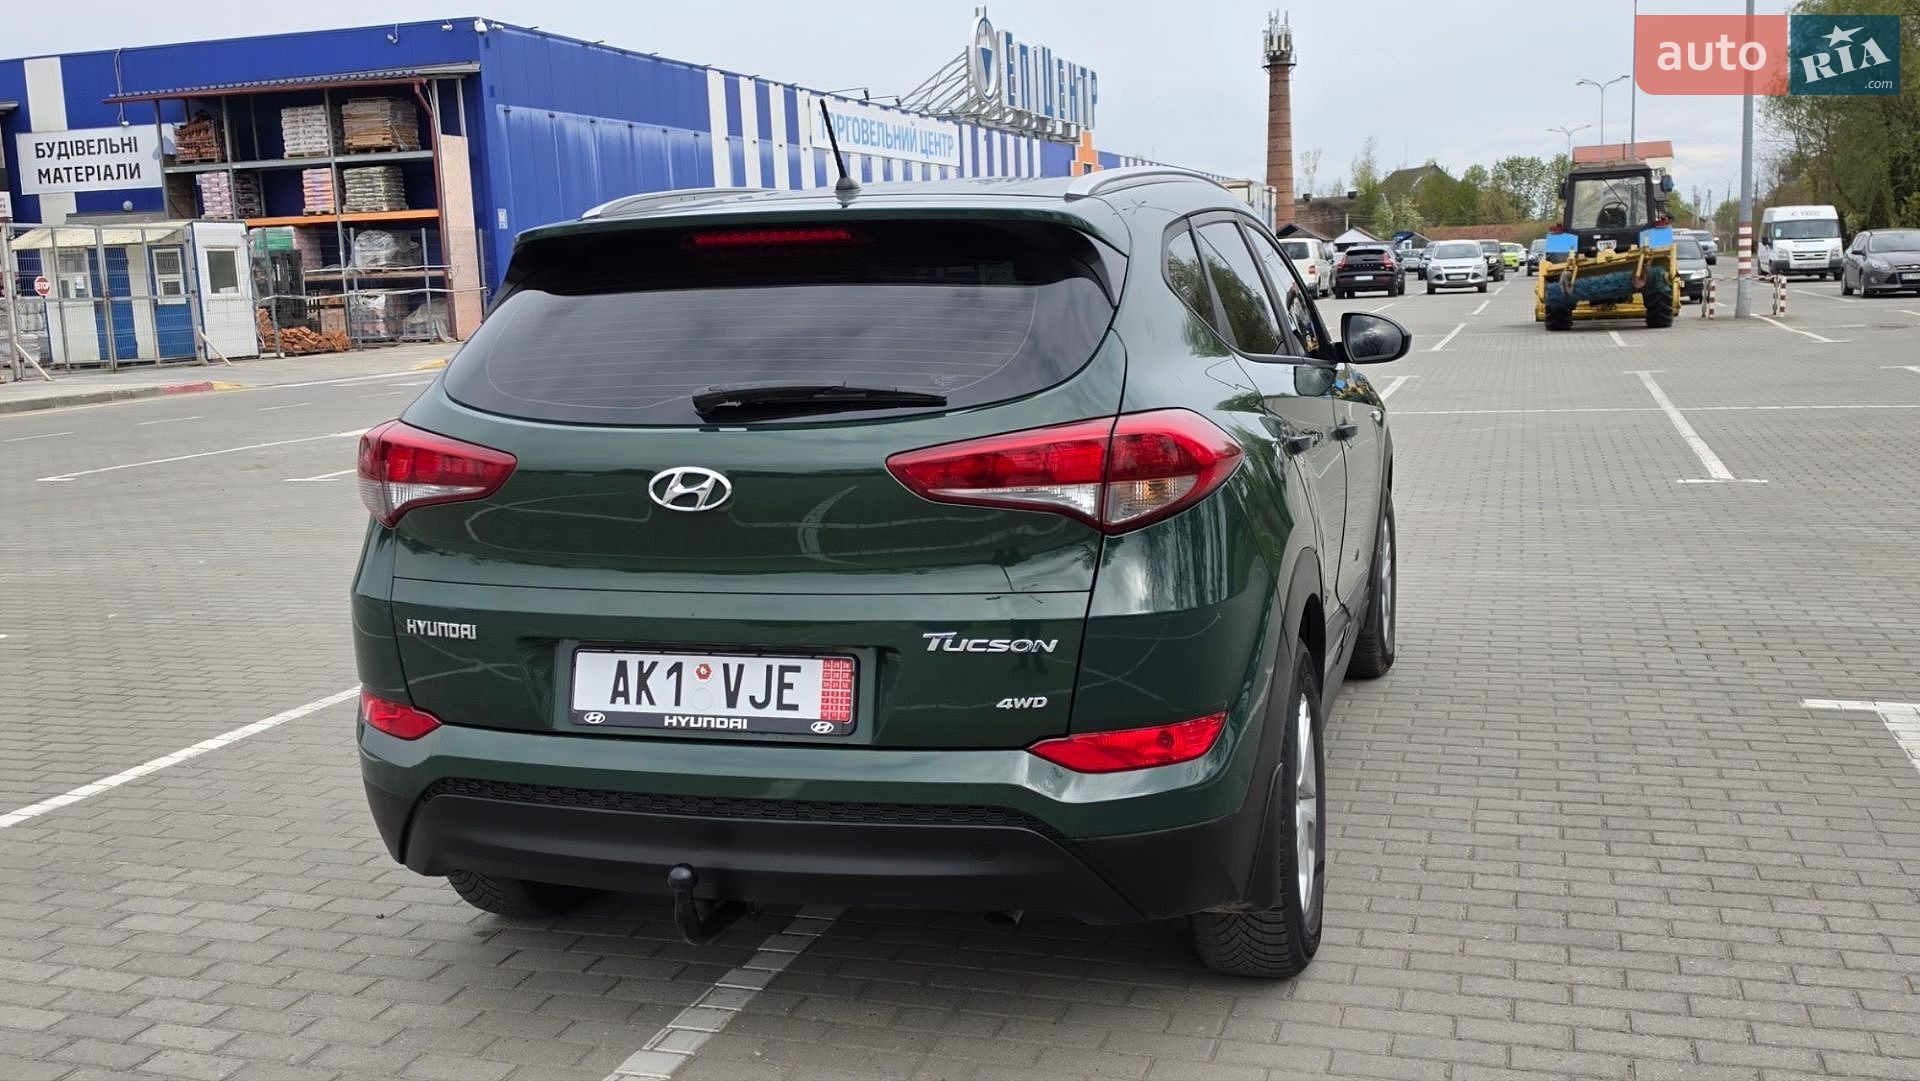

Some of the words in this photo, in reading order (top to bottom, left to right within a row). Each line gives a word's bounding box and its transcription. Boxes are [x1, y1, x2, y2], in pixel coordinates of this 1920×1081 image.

[34, 136, 138, 160] БУДІВЕЛЬНІ
[920, 129, 954, 159] ЦЕНТР
[37, 162, 141, 185] МАТЕРІАЛИ
[406, 618, 477, 639] HYUNDAI
[722, 663, 802, 711] VJE
[996, 696, 1048, 709] 4WD
[663, 715, 748, 730] HYUNDAI
